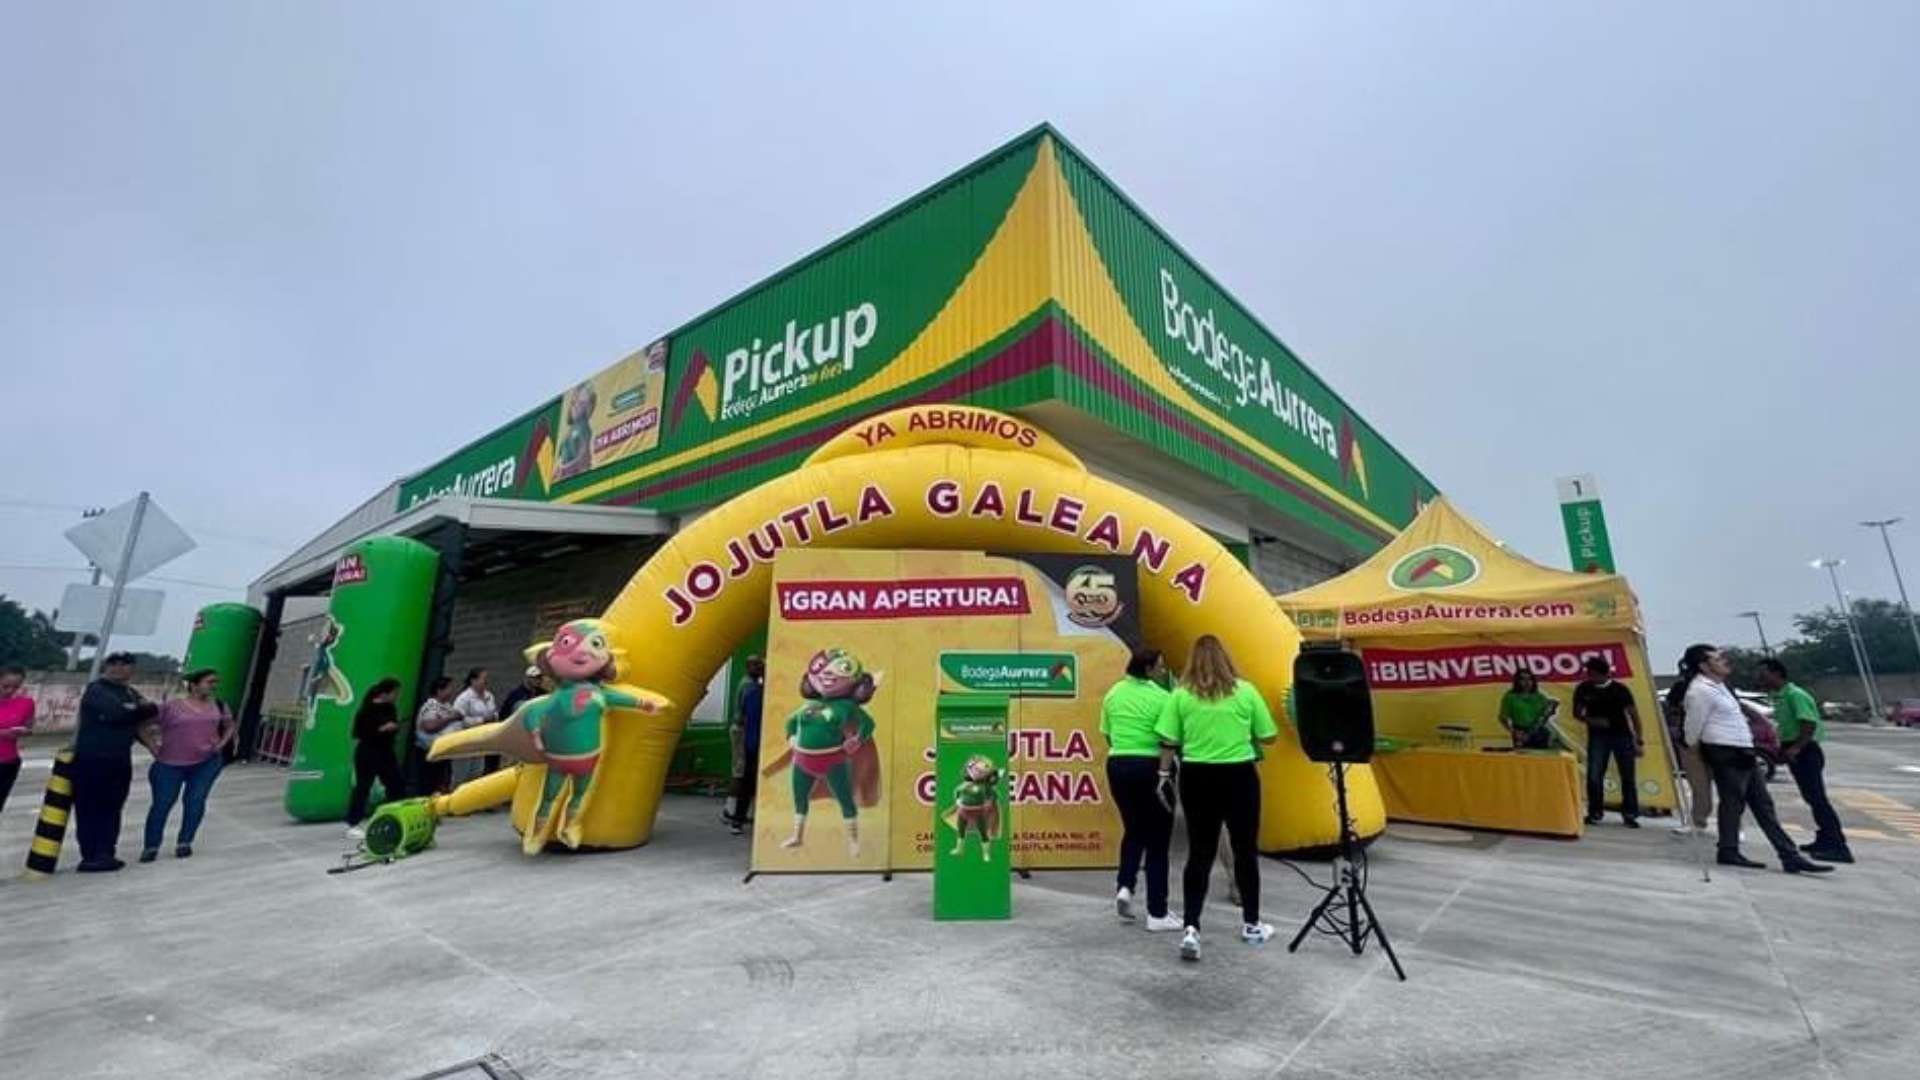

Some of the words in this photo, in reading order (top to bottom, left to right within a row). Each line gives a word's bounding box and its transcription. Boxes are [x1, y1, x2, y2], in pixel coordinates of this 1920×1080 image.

[722, 302, 877, 404] Pickup
[1161, 268, 1338, 459] BodegaAurrera
[857, 422, 895, 447] YA
[908, 411, 1038, 448] ABRIMOS
[1572, 480, 1582, 496] 1
[664, 485, 894, 625] JOJUTLA
[926, 481, 1206, 602] GALEANA
[783, 590, 866, 611] ¡GRAN
[873, 586, 1018, 609] APERTURA!
[1344, 603, 1575, 626] BodegaAurrera.com
[916, 773, 1100, 802] GEANA
